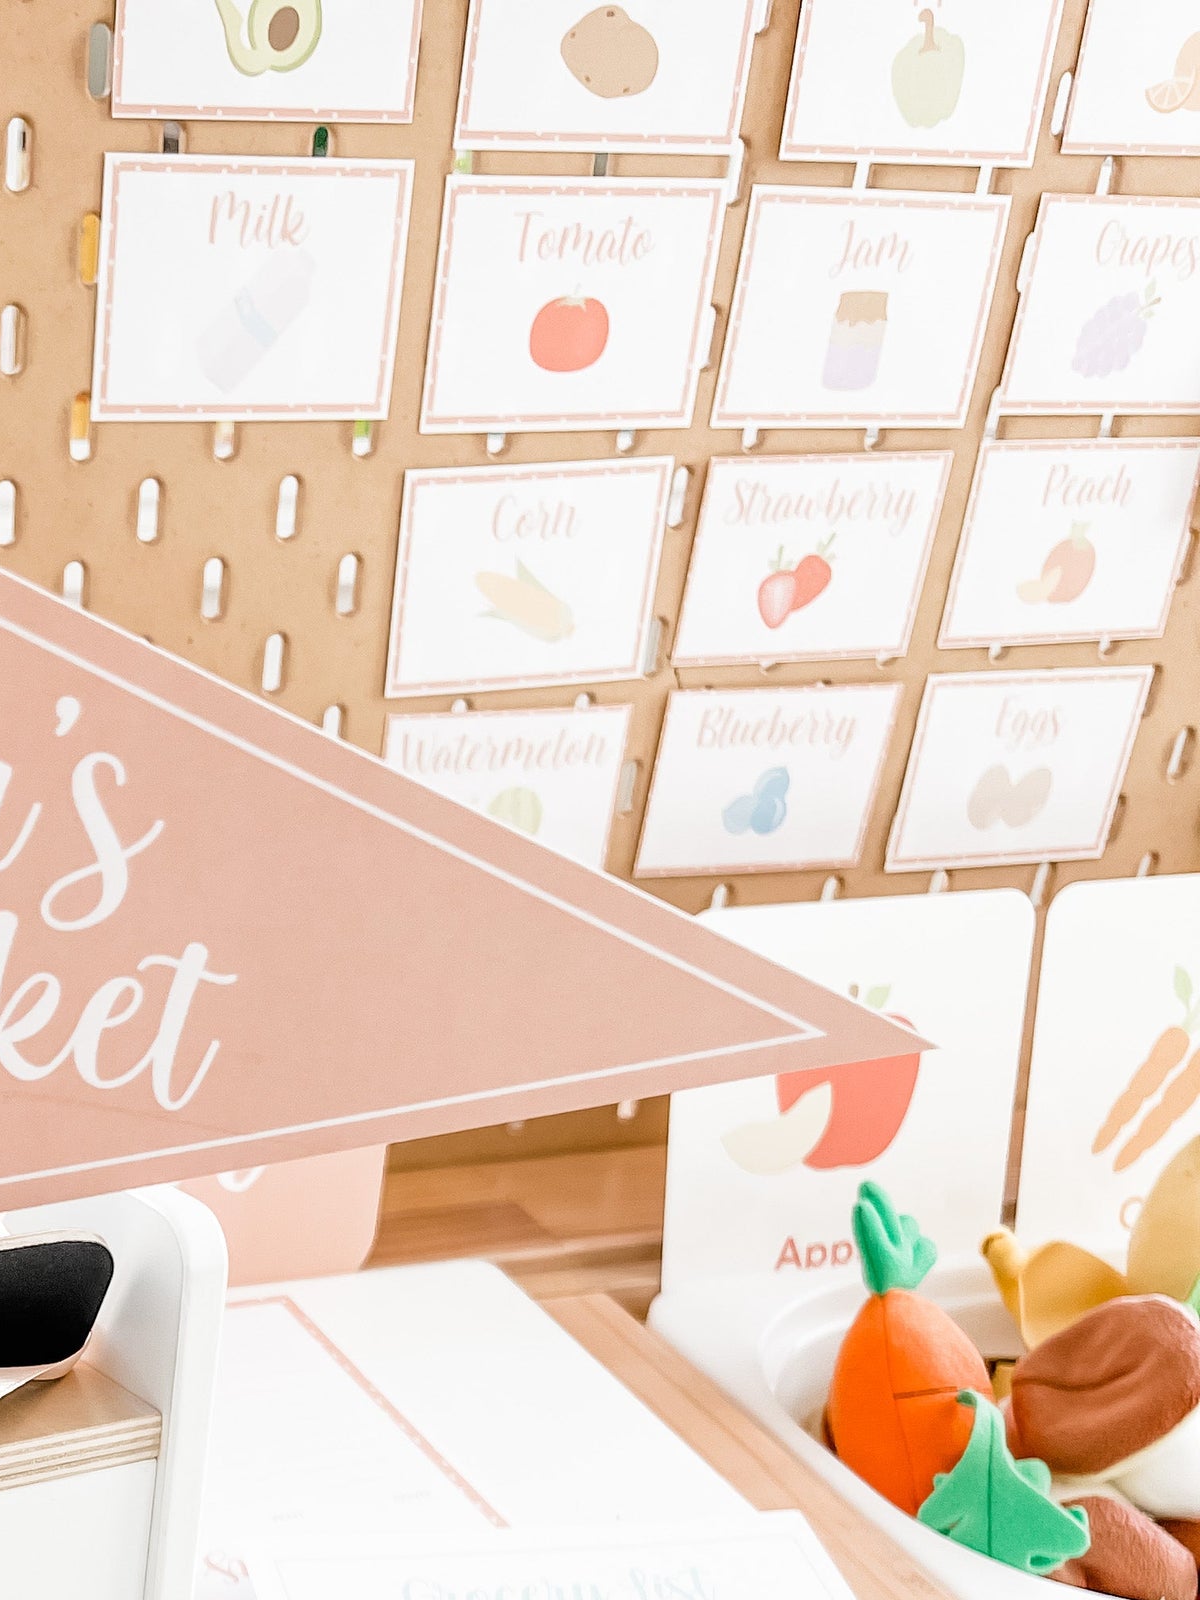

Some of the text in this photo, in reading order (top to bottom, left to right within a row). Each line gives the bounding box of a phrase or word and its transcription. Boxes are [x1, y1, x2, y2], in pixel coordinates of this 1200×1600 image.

[207, 190, 312, 248] Milk
[512, 210, 656, 266] Tomato
[828, 219, 913, 278] Jam
[1095, 218, 1200, 281] Grapes
[723, 476, 921, 540] Strawberry
[1038, 460, 1137, 510] Peach
[489, 492, 582, 543] Corn
[694, 707, 858, 753] Blueberry
[993, 695, 1066, 746] Eggs
[400, 727, 610, 775] Watermelon
[775, 1235, 853, 1270] App
